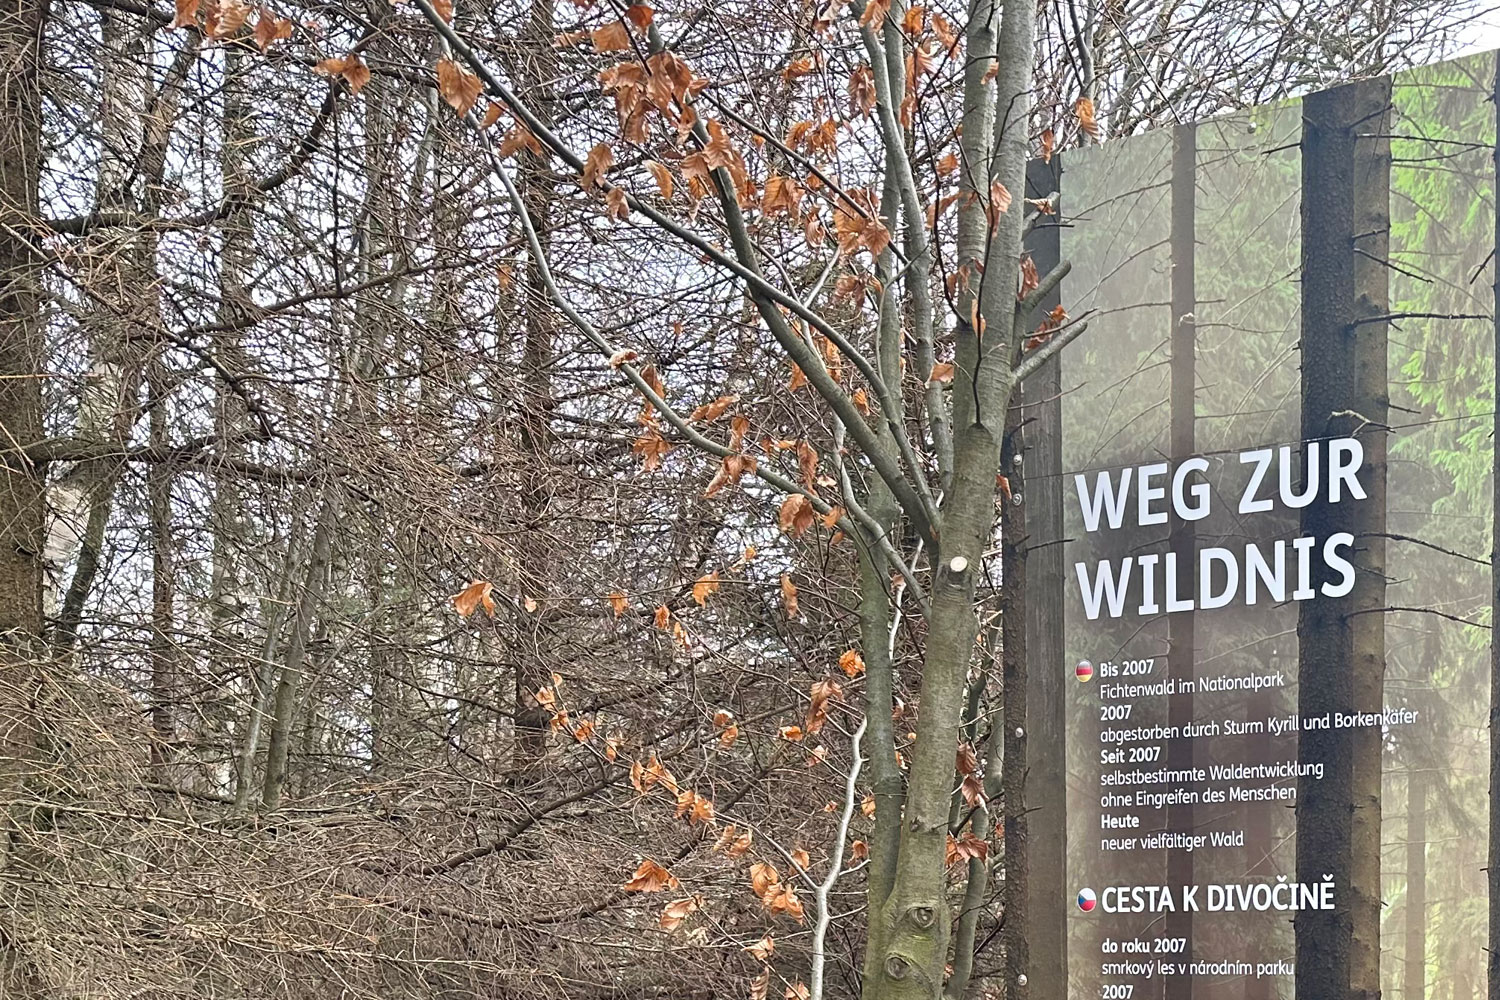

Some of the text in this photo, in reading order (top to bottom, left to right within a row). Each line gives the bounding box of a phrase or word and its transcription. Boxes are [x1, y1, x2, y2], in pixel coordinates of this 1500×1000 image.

[1074, 437, 1368, 532] WEG ZUR
[1074, 532, 1356, 620] WILDNIS
[1100, 659, 1154, 677] Bis 2007
[1100, 671, 1284, 699] Fichtenwald im Nationalpark
[1100, 705, 1132, 721] 2007
[1100, 707, 1418, 745] abgestorben durch Sturm Kyrill und Borkenkäfer
[1101, 747, 1161, 764] Seit 2007
[1101, 760, 1324, 786] selbstbestimmte Waldentwicklung
[1101, 784, 1297, 809] ohne Eingreifen des Menschen
[1101, 814, 1140, 829] Heute
[1101, 830, 1244, 852] neuer vielfältiger Wald
[1101, 873, 1335, 913] CESTA K DIVOČINĚ
[1101, 937, 1186, 953] do roku 2007
[1102, 959, 1295, 979] smrkový les v národním parku
[1102, 985, 1133, 999] 2007
